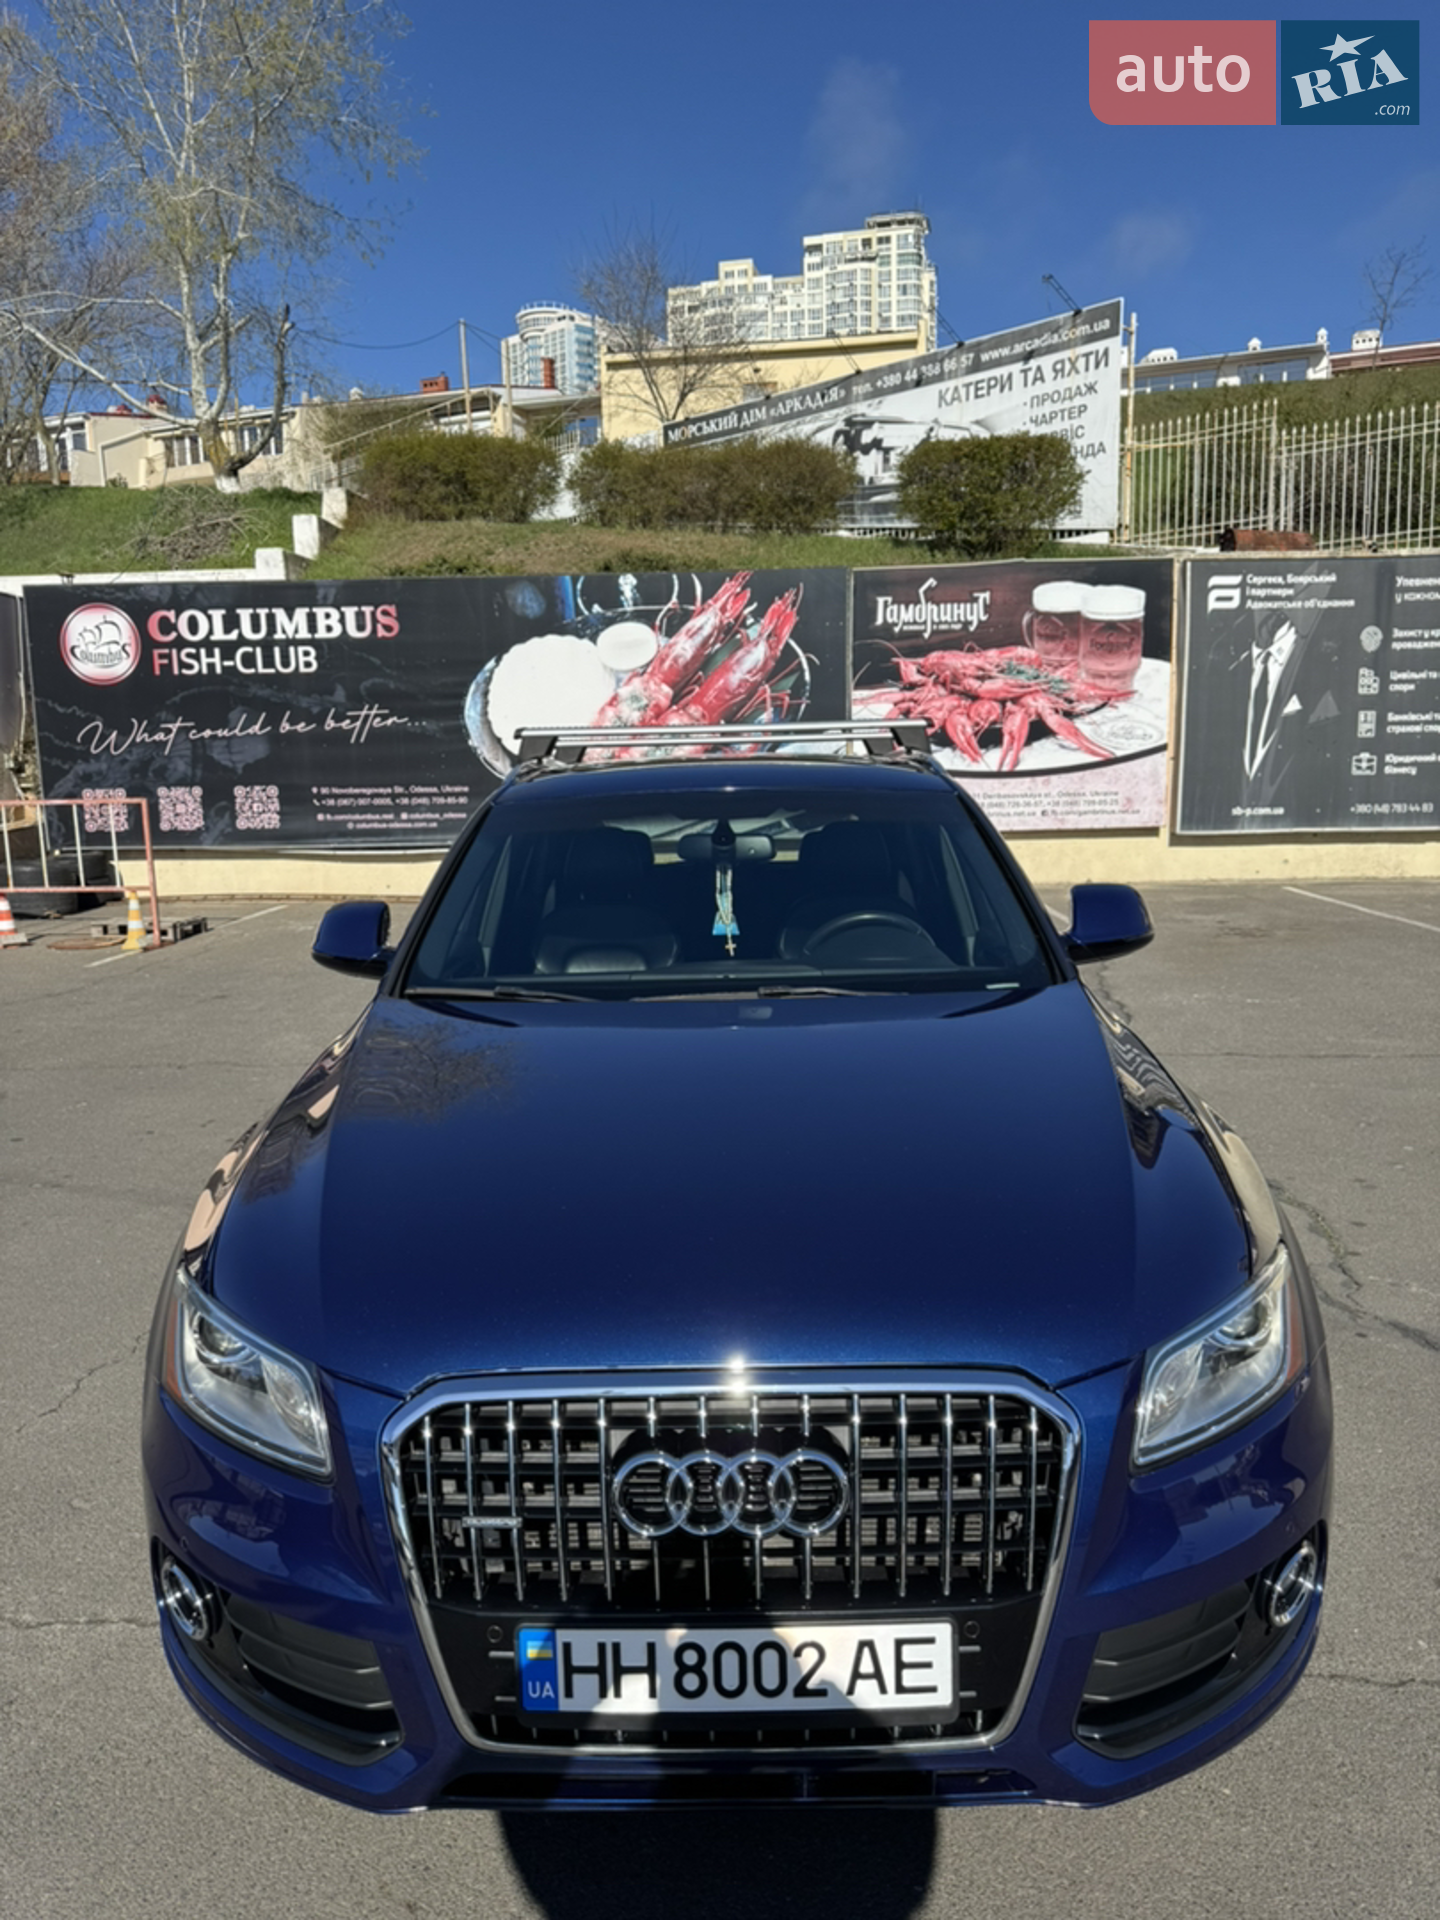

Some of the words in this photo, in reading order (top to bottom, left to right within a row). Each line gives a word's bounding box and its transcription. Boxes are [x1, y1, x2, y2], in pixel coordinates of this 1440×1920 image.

[876, 371, 902, 390] +380
[904, 368, 918, 383] 44
[960, 353, 975, 369] 57
[980, 317, 1112, 363] www.arcadia.com.ua
[937, 370, 1014, 409] КАТЕРИ
[1020, 362, 1046, 389] ТА
[1052, 347, 1110, 381] ЯХТИ
[668, 410, 739, 443] МОРСЬКИЙ
[740, 405, 768, 429] ДІМ
[769, 386, 846, 417] «АРКАДІЯ»
[1029, 404, 1088, 427] ЧАРТЕР
[1030, 380, 1098, 409] ПРОДАЖ
[147, 603, 400, 643] COLUMBUS
[874, 577, 991, 640] Гамбринус
[152, 645, 319, 676] FISH-CLUB
[77, 716, 195, 755] What
[189, 712, 272, 739] could
[279, 710, 316, 733] be
[324, 703, 427, 744] better...
[528, 1681, 555, 1699] UA
[562, 1641, 657, 1699] HH
[673, 1640, 828, 1699] 8002
[845, 1636, 938, 1695] AE
